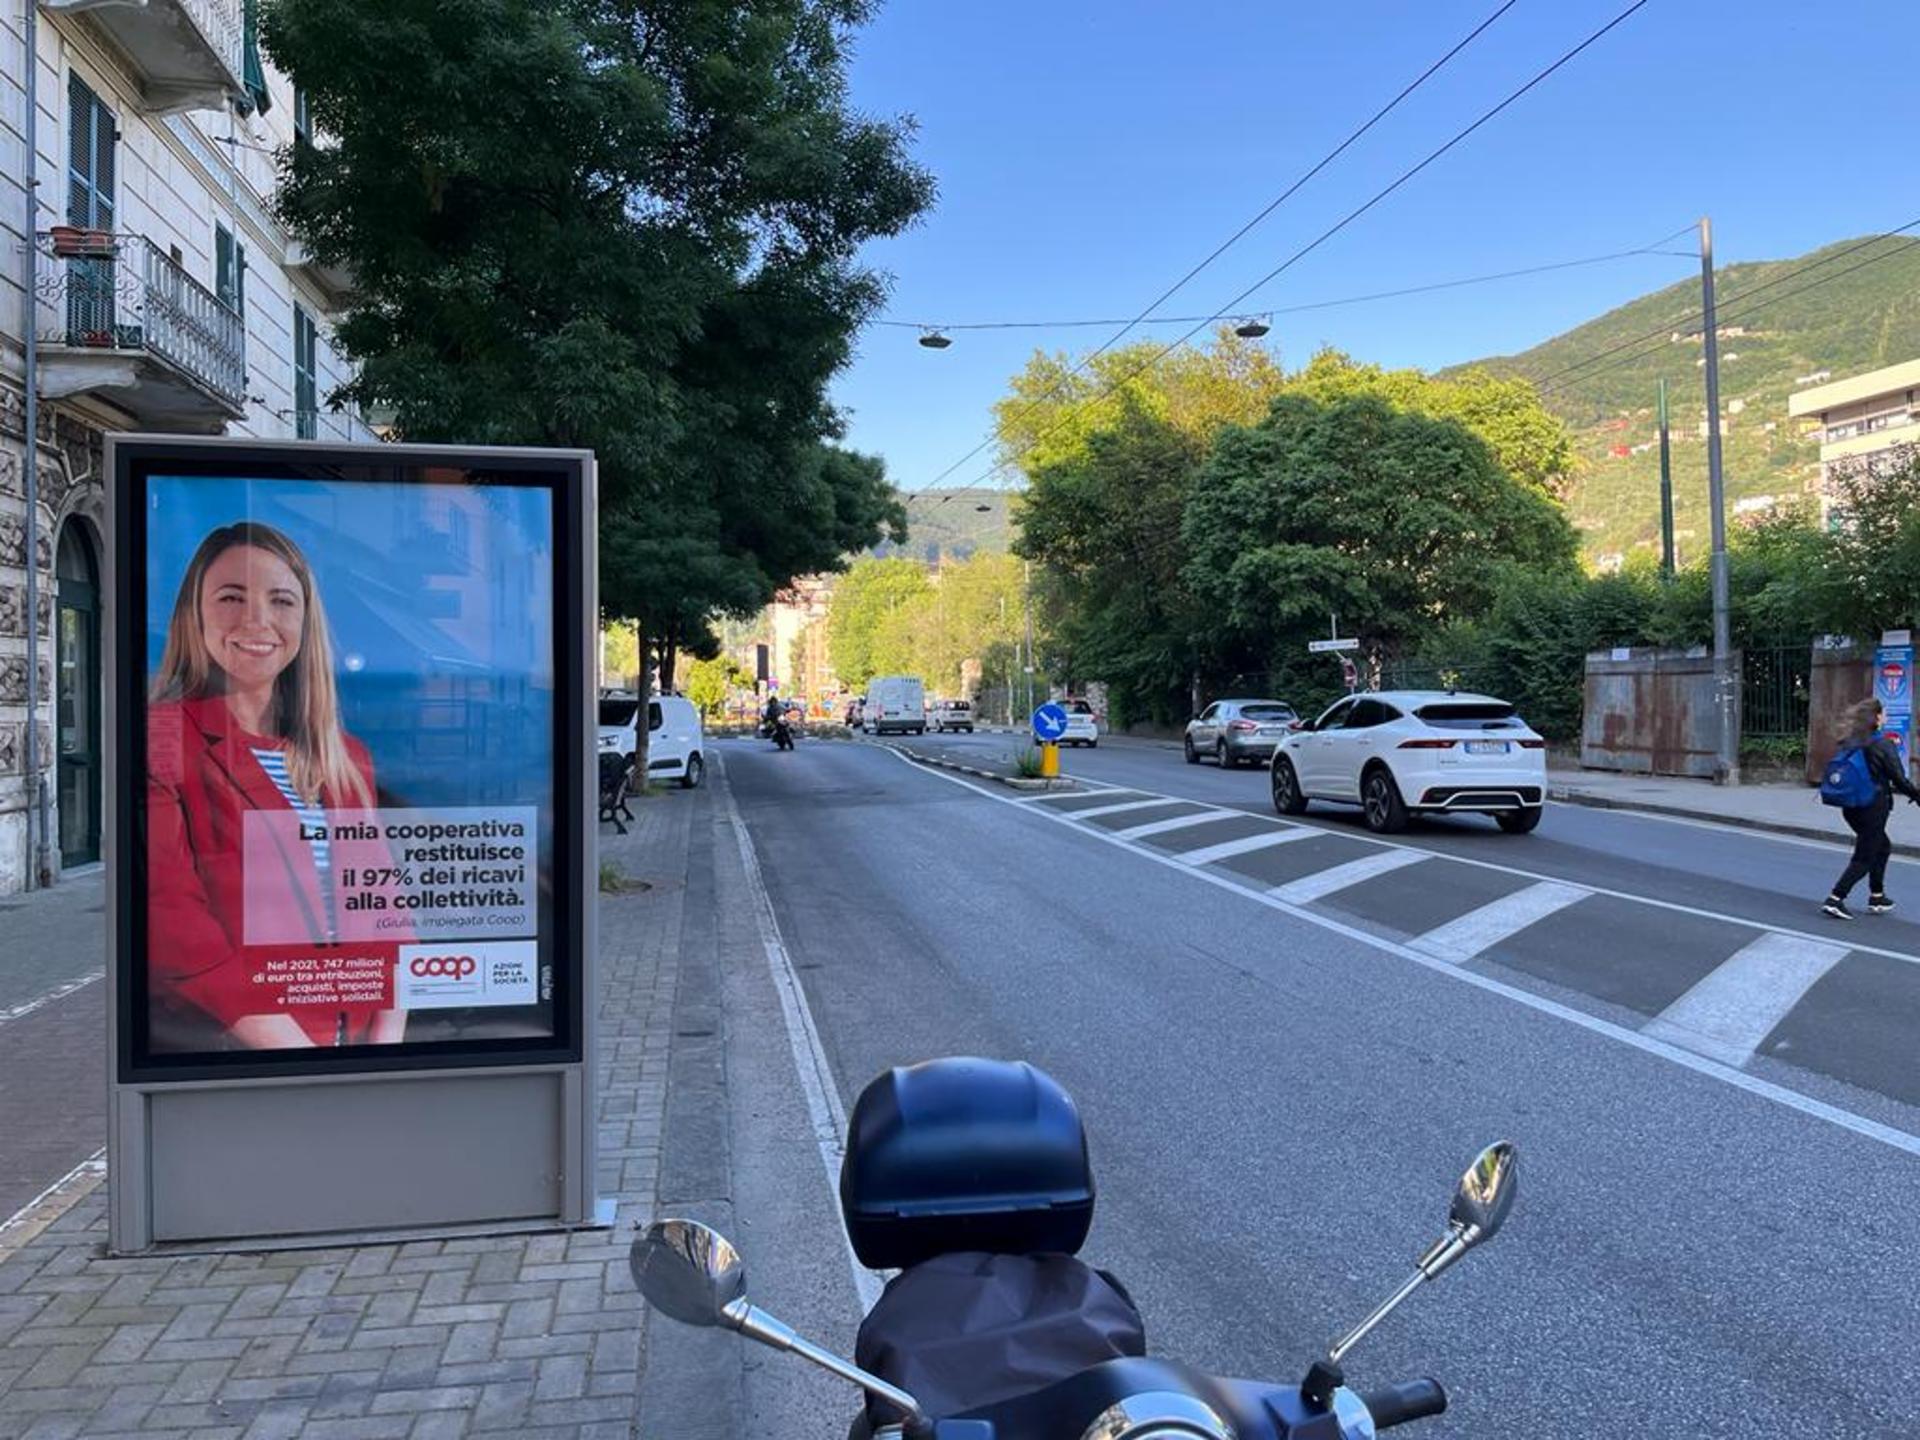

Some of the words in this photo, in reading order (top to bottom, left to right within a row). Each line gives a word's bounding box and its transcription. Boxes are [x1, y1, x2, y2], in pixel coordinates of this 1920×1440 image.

[300, 823, 328, 841] La
[334, 822, 379, 840] mia
[385, 820, 525, 842] cooperativa
[404, 844, 525, 863] restituisce
[343, 869, 355, 887] il
[362, 868, 413, 887] 97%
[419, 867, 455, 886] dei
[462, 865, 525, 884] ricavi
[345, 892, 387, 911] alla
[393, 888, 526, 909] collettività.
[422, 915, 484, 929] impiegata
[487, 914, 526, 927] Coop)
[267, 961, 287, 971] Nel
[289, 960, 320, 970] 2021,
[323, 959, 343, 969] 747
[346, 957, 385, 968] milioni
[410, 956, 476, 981] coop
[252, 973, 265, 983] di
[267, 973, 295, 983] euro
[297, 972, 313, 981] tra
[315, 969, 384, 981] retribuzioni,
[287, 981, 336, 993] acquisti,
[338, 981, 384, 992] imposte
[287, 993, 339, 1005] iniziative
[341, 991, 384, 1002] solidali.
